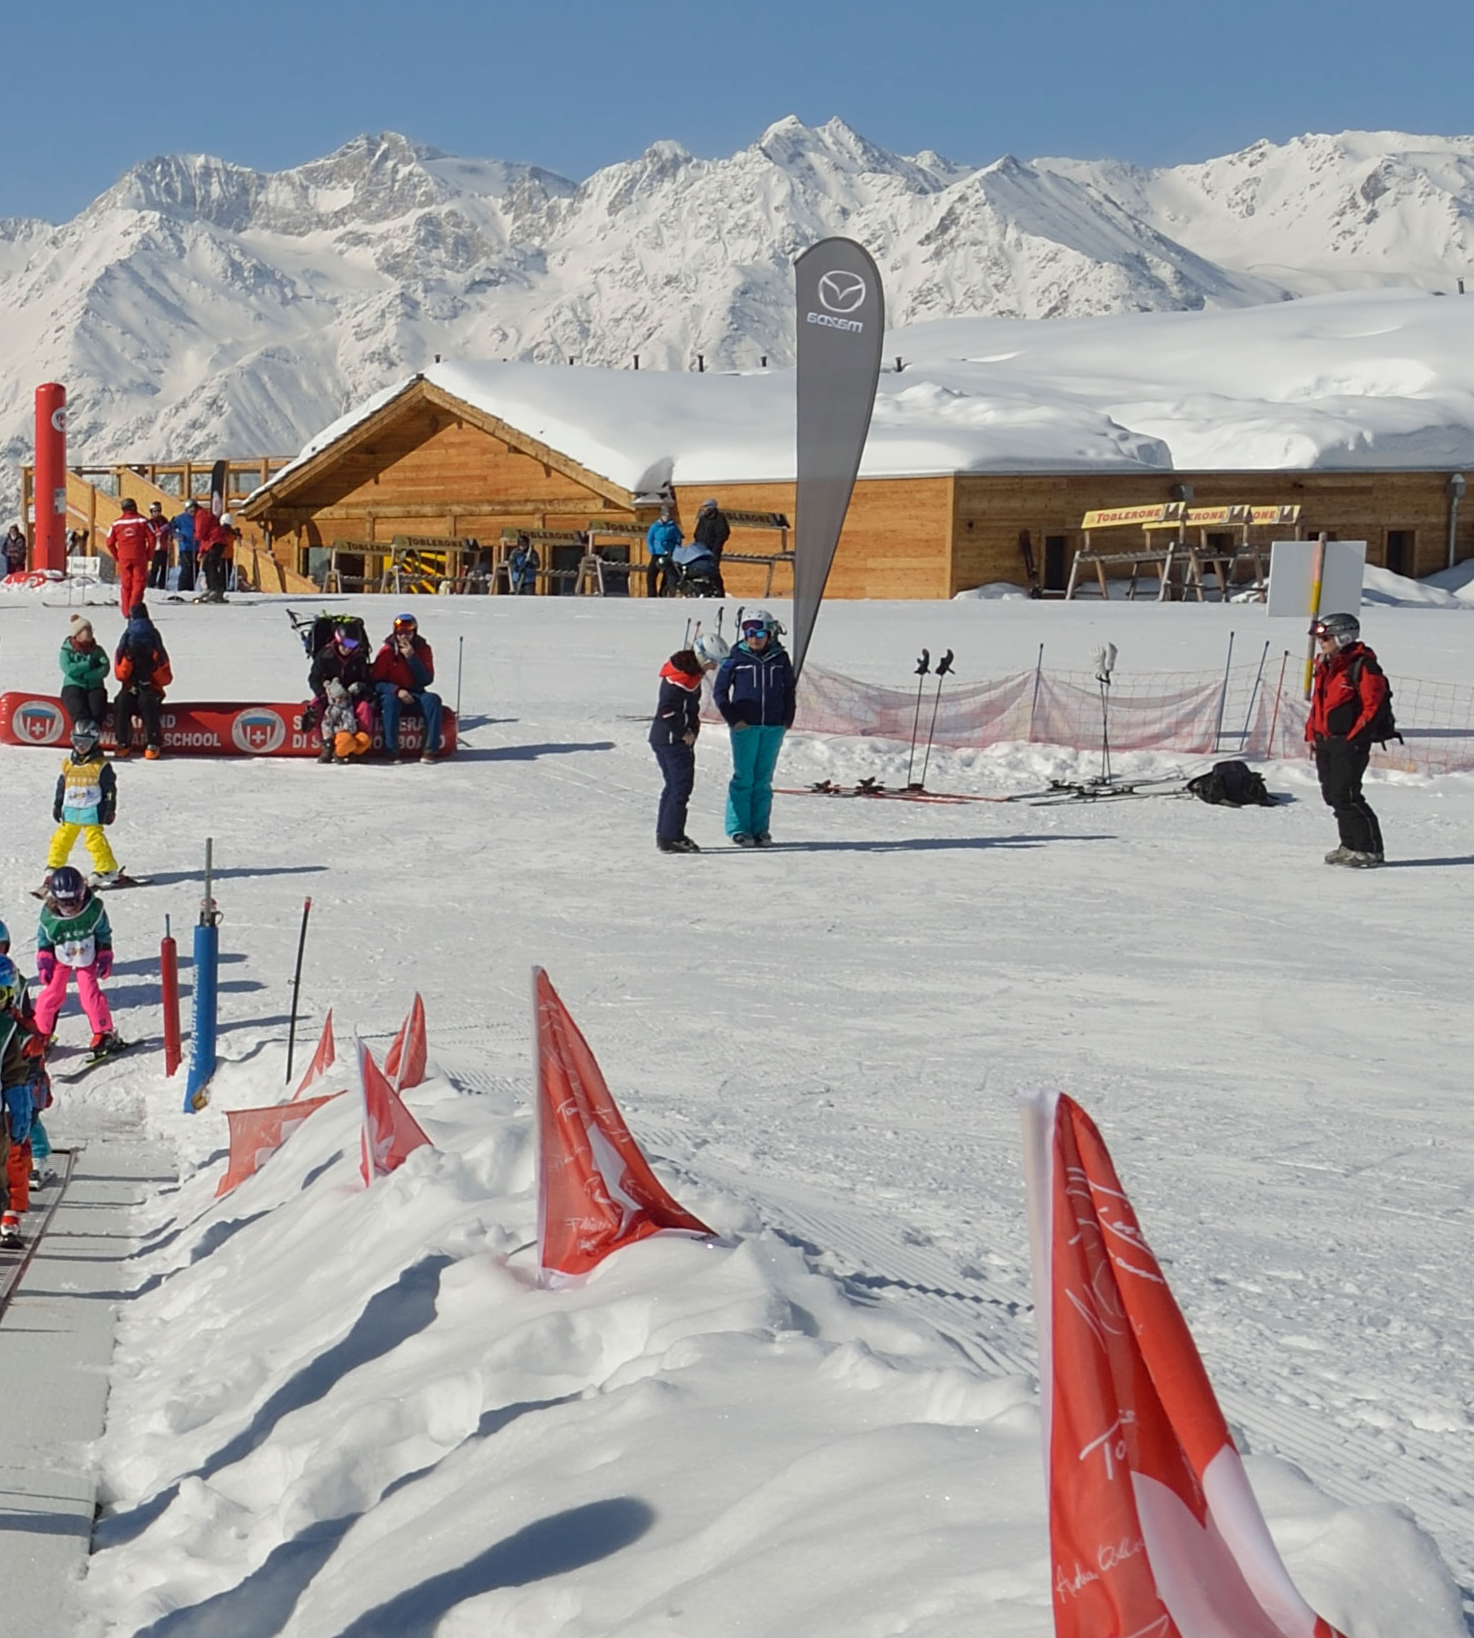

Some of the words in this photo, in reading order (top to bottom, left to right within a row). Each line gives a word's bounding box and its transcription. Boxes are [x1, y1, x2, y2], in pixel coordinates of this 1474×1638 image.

[1096, 508, 1162, 524] TOBLERONE
[406, 537, 464, 549] TOBLERONE
[163, 732, 222, 747] SCHOOL
[292, 733, 307, 749] DI
